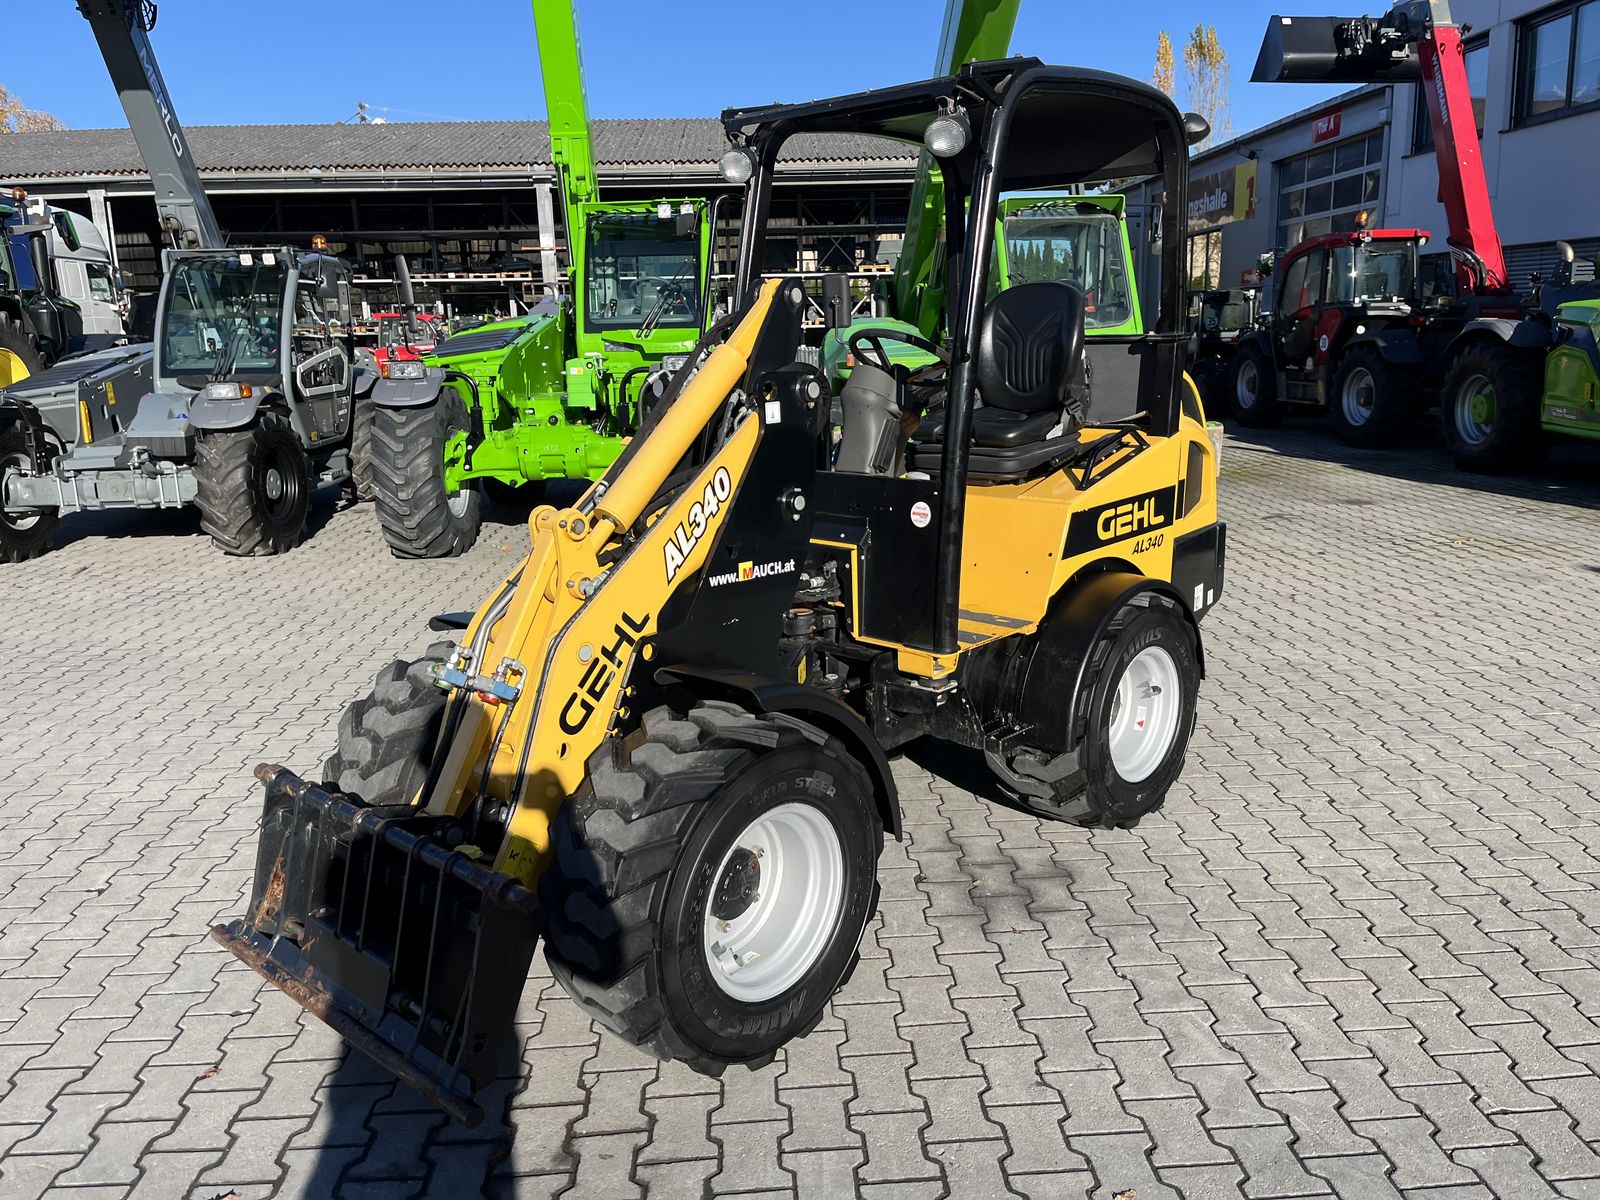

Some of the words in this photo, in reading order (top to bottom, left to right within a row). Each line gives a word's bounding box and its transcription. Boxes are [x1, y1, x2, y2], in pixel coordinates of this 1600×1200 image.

[140, 48, 183, 157] MERLO
[1432, 52, 1449, 124] WEIDEMANN
[1245, 176, 1256, 219] 1
[663, 466, 731, 586] AL340
[1096, 496, 1165, 541] GEHL
[1131, 533, 1164, 556] AL340
[708, 558, 796, 587] www.MAUCH.at
[559, 611, 651, 736] GEHL
[795, 776, 837, 799] STEER
